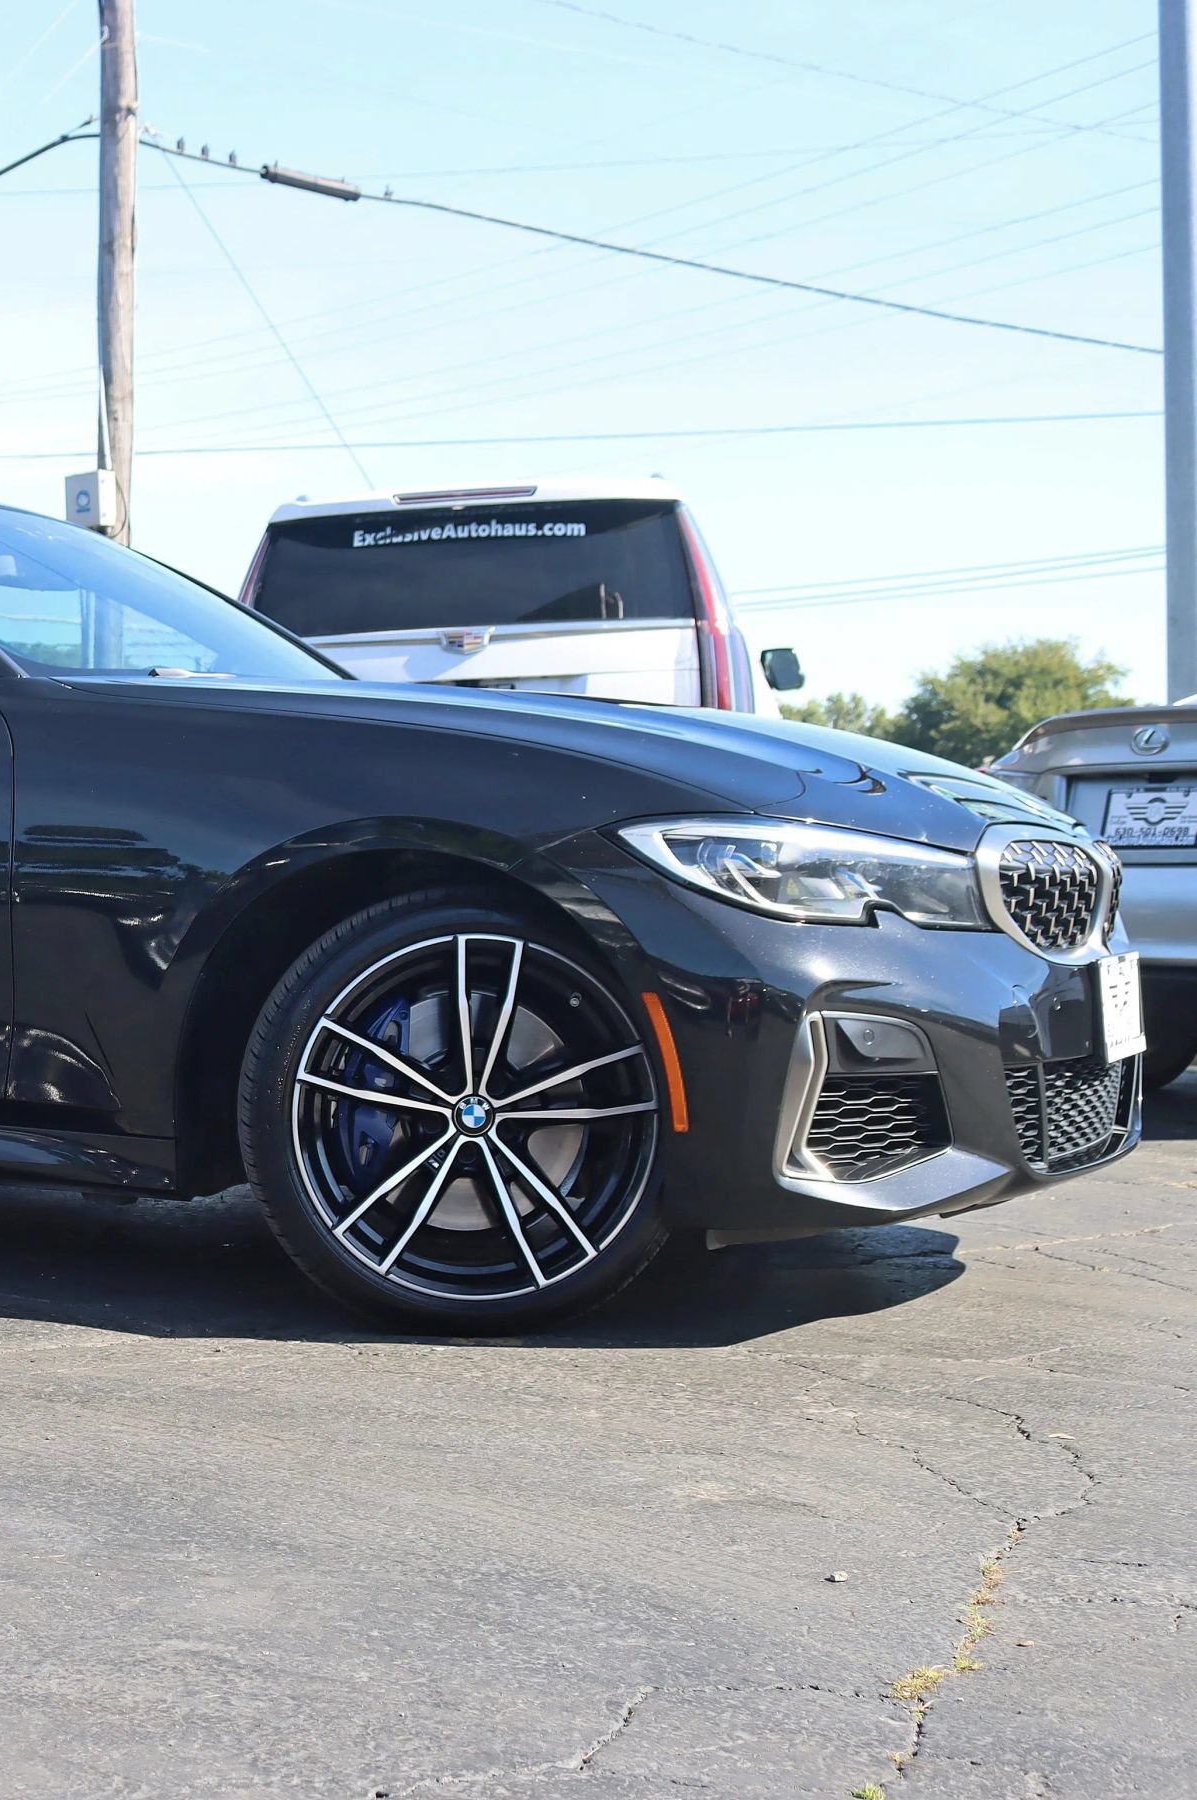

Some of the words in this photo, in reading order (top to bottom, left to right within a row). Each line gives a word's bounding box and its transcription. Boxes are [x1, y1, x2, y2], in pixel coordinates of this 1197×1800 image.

[352, 518, 587, 548] ExclusiveAutohaus.com
[1115, 827, 1189, 837] 630-501-0698
[459, 1098, 490, 1110] BMW
